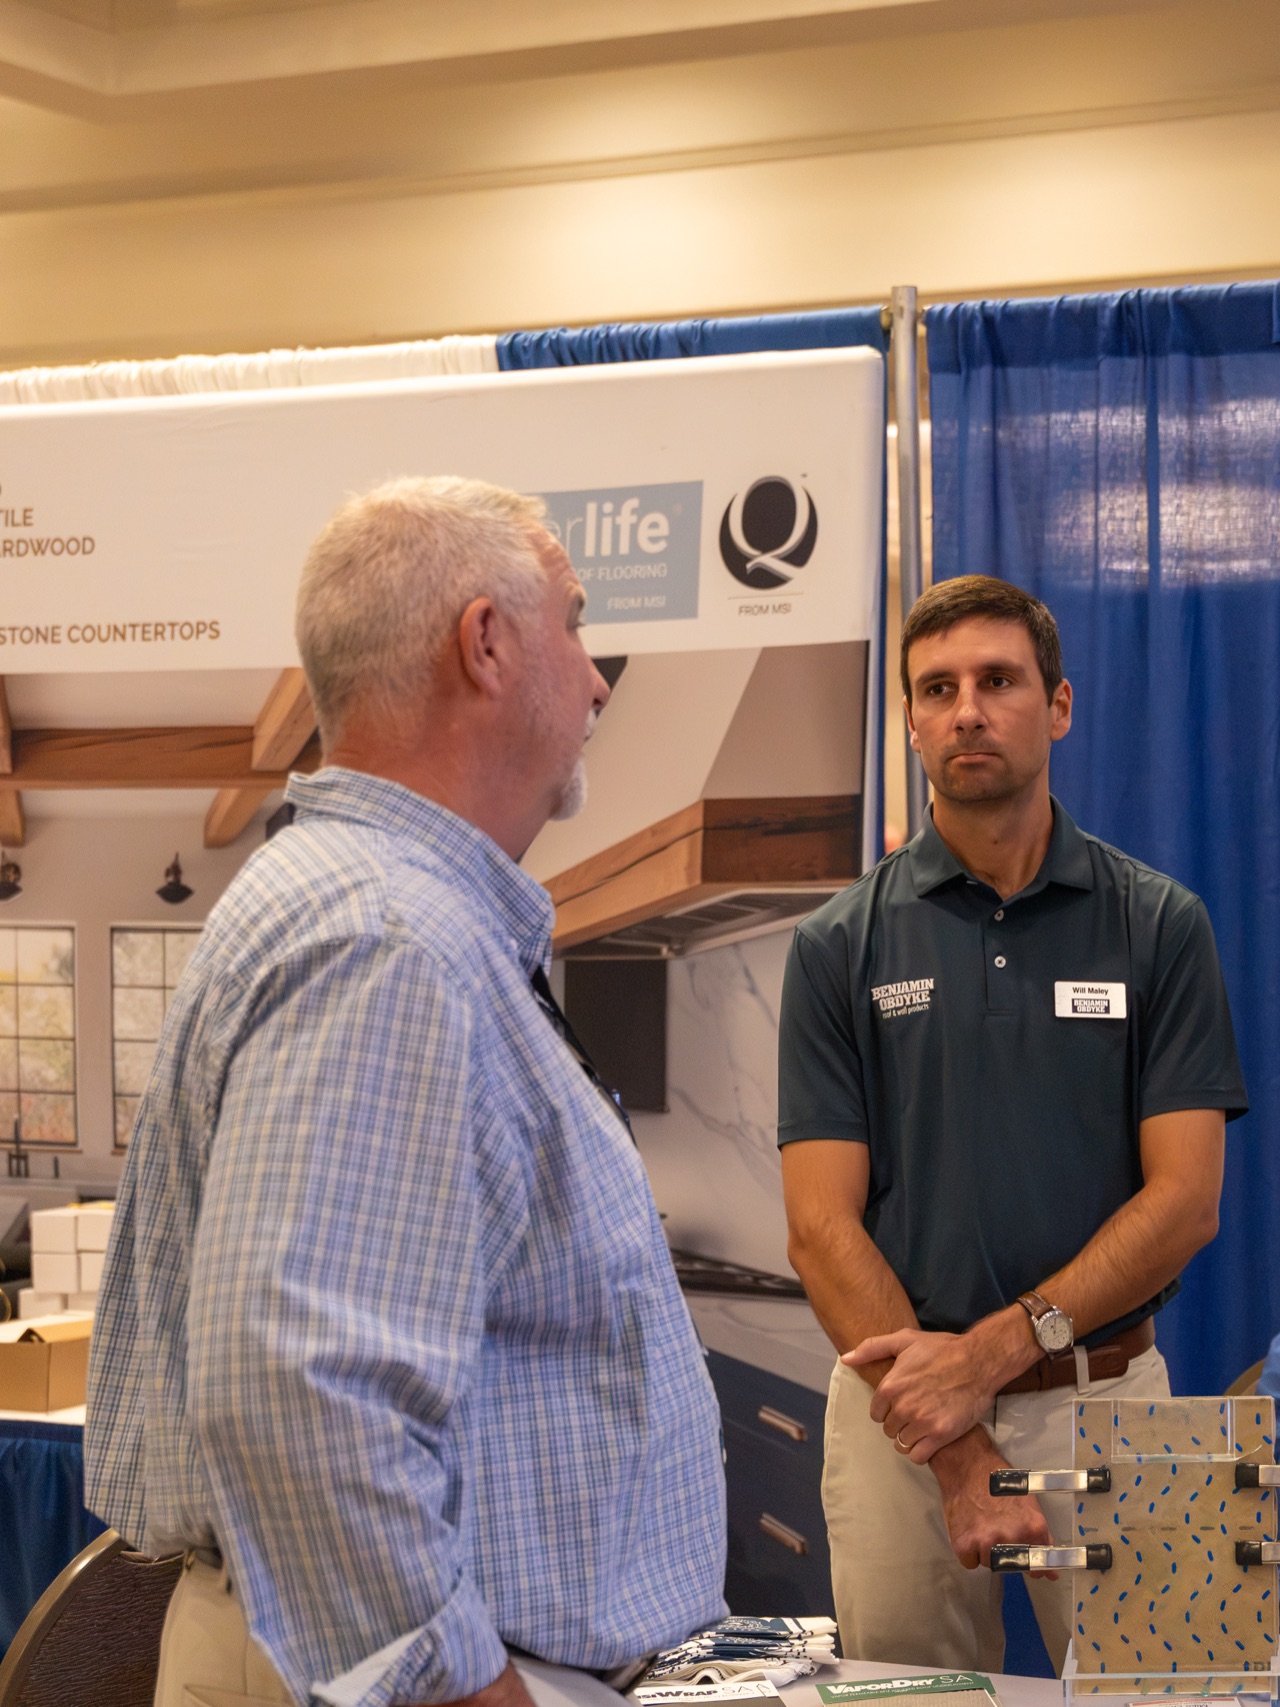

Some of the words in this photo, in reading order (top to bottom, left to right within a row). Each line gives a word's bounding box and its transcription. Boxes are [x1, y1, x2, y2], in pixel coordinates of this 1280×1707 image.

[0, 536, 95, 558] RDWOOD
[598, 563, 667, 580] FLOORING
[738, 604, 769, 617] FROM
[771, 603, 792, 615] MSI
[67, 621, 221, 644] COUNTERTOPS
[871, 978, 935, 1001] BENJAMIN
[1072, 986, 1086, 994] Will
[1088, 987, 1109, 996] Maley
[879, 990, 931, 1011] OBDYKE
[1073, 999, 1108, 1007] BENJAMIN
[939, 1674, 973, 1684] SA
